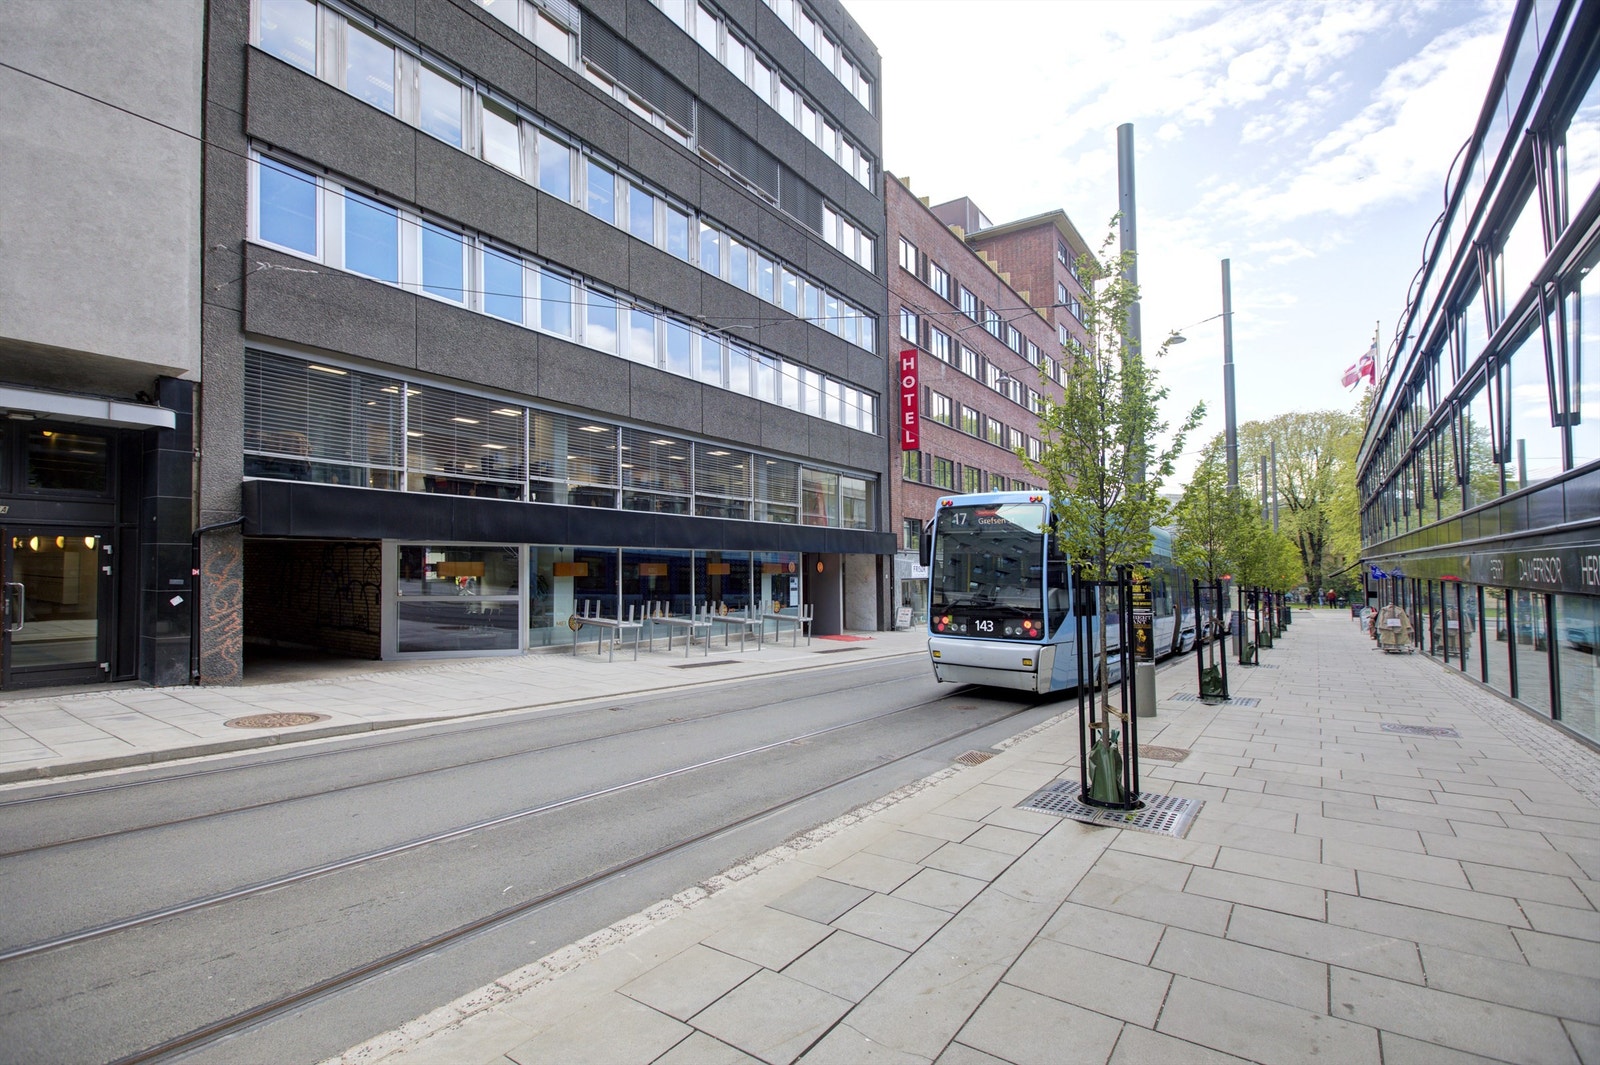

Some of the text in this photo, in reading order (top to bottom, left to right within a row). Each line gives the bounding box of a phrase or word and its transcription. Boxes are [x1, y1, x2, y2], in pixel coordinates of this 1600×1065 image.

[902, 357, 916, 443] HOTEL
[977, 517, 1006, 525] Grefsen
[1580, 555, 1600, 586] HER
[974, 619, 994, 632] 143
